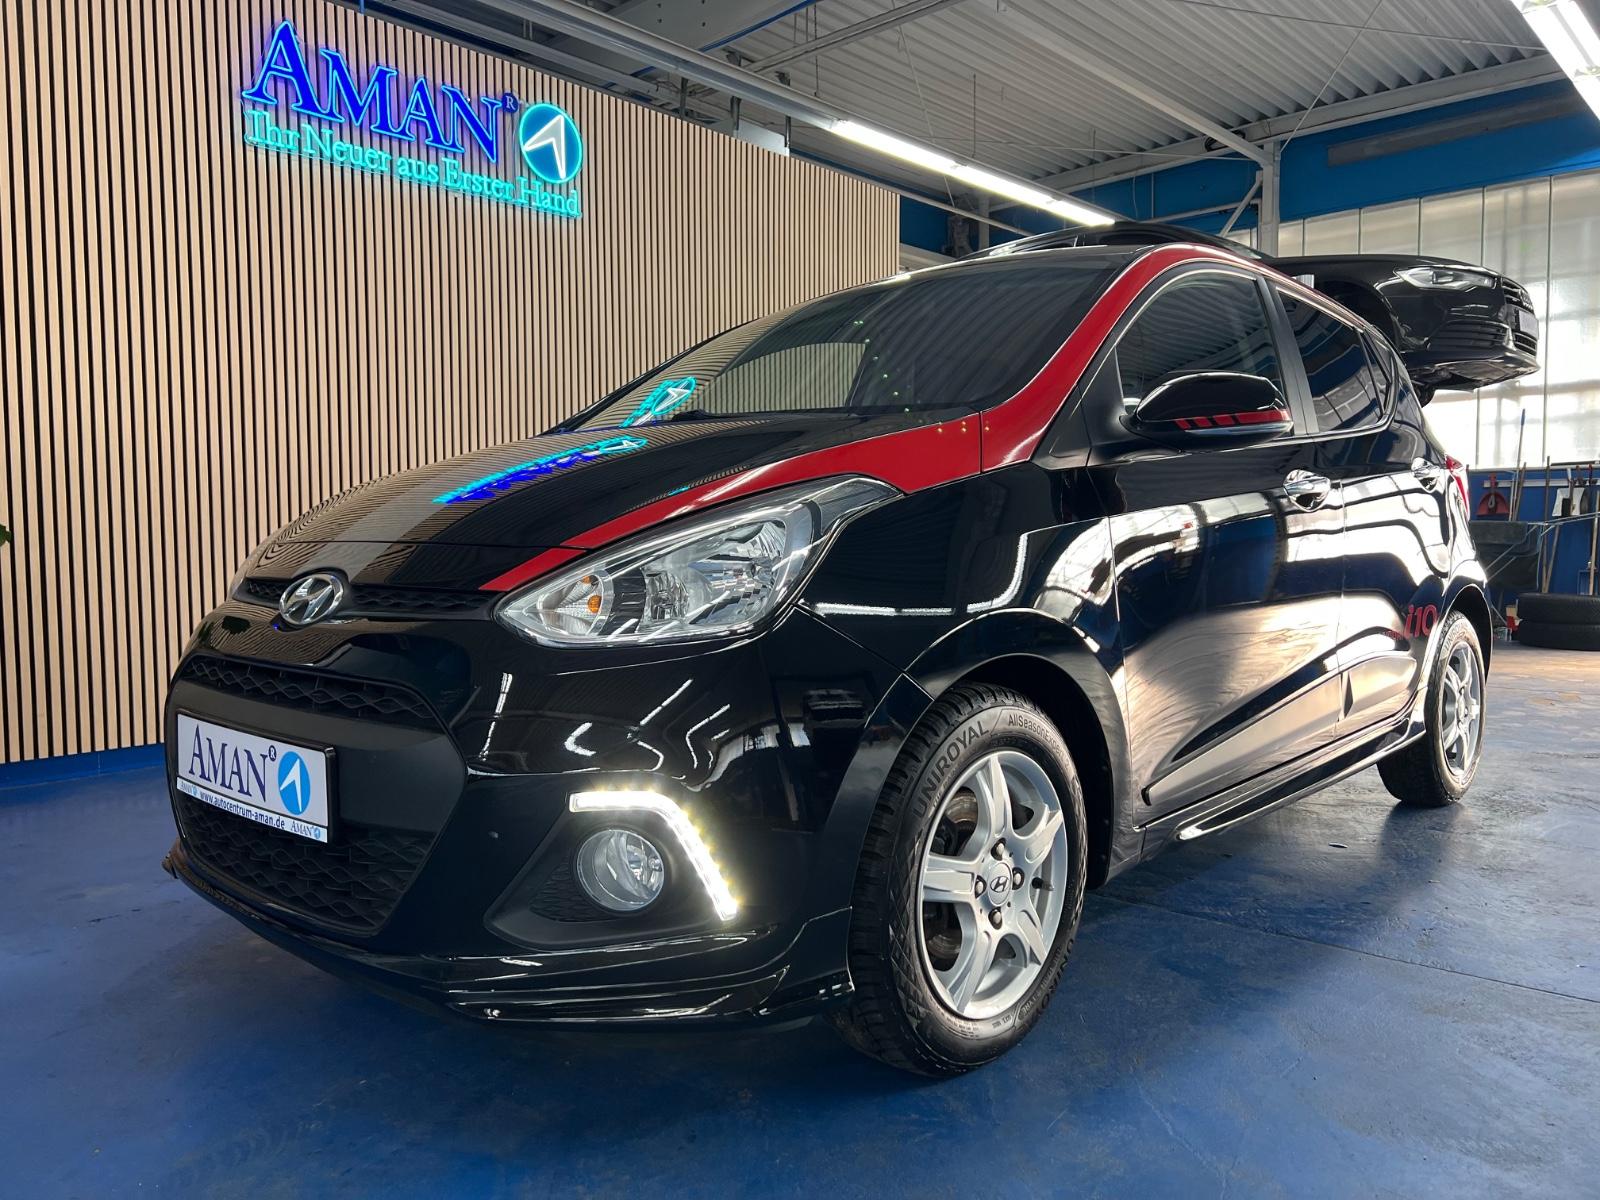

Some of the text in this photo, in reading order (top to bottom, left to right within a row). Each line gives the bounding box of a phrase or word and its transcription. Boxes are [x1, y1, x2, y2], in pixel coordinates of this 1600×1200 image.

[246, 109, 582, 218] Ihr Neuer aus Erster Hand
[1404, 603, 1437, 639] i10
[912, 720, 990, 818] UNIROYAL
[200, 790, 285, 830] www.autocentrum-aman.de
